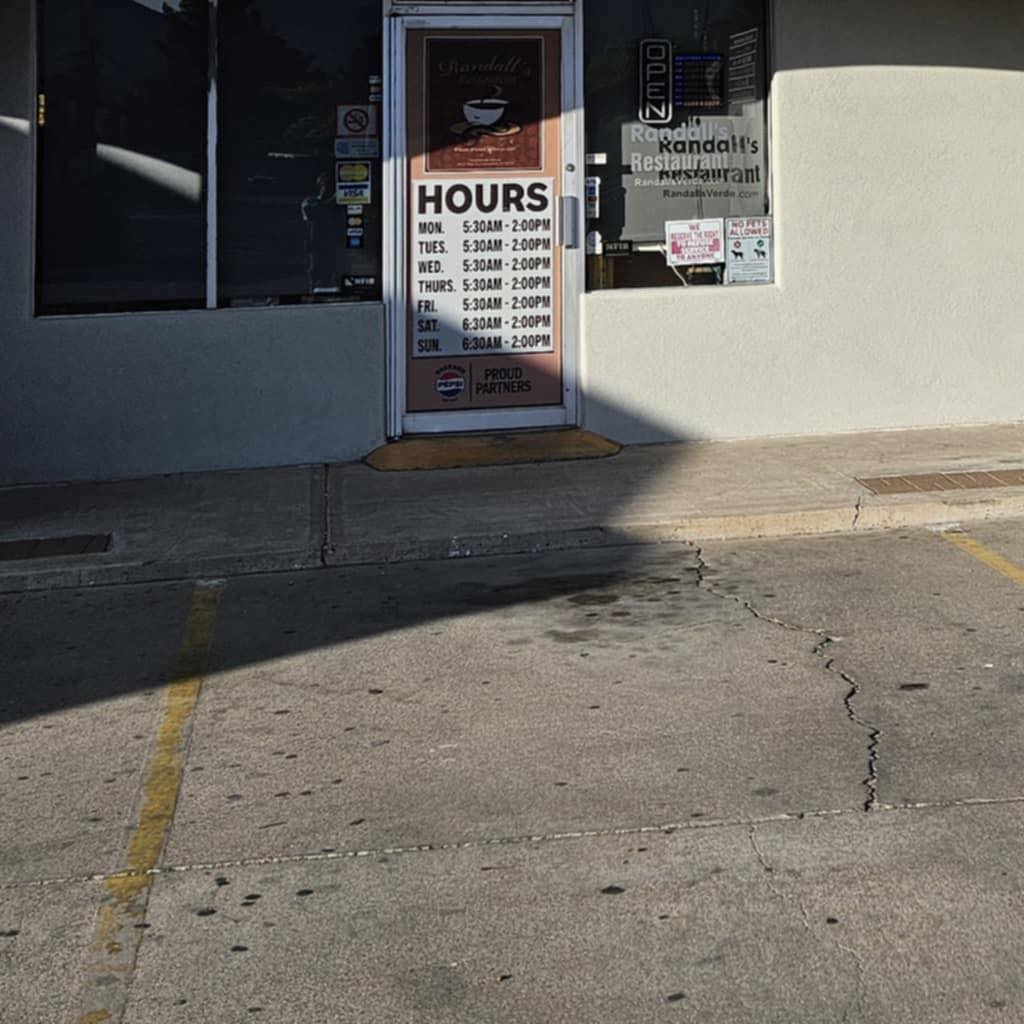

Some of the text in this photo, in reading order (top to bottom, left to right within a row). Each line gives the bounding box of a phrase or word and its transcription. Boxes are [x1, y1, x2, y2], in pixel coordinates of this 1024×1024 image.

[645, 44, 667, 119] OPEN
[418, 182, 549, 214] HOURS
[418, 221, 445, 235] MON.
[462, 219, 501, 234] 5:30AM
[511, 218, 551, 232] 2:00PM
[746, 219, 766, 227] PETS
[418, 241, 449, 255] TUES.
[462, 238, 501, 252] 5:30AM
[511, 237, 551, 252] 2:00PM
[418, 260, 444, 274] WED.
[462, 257, 501, 272] 5:30AM
[511, 257, 551, 271] 2:00PM
[418, 279, 456, 293] THURS.
[462, 277, 501, 291] 5:30AM
[511, 276, 551, 289] 2:00PM
[417, 299, 438, 313] FRI.
[462, 296, 501, 311] 5:30AM
[511, 295, 551, 309] 2:00PM
[417, 318, 440, 333] SAT.
[462, 316, 501, 331] 6:30AM
[511, 314, 551, 328] 2:00PM
[417, 338, 442, 353] SUN.
[462, 335, 501, 350] 6:30AM
[511, 334, 551, 348] 2:00PM
[484, 367, 523, 381] PROUD
[475, 380, 532, 394] PARTNERS
